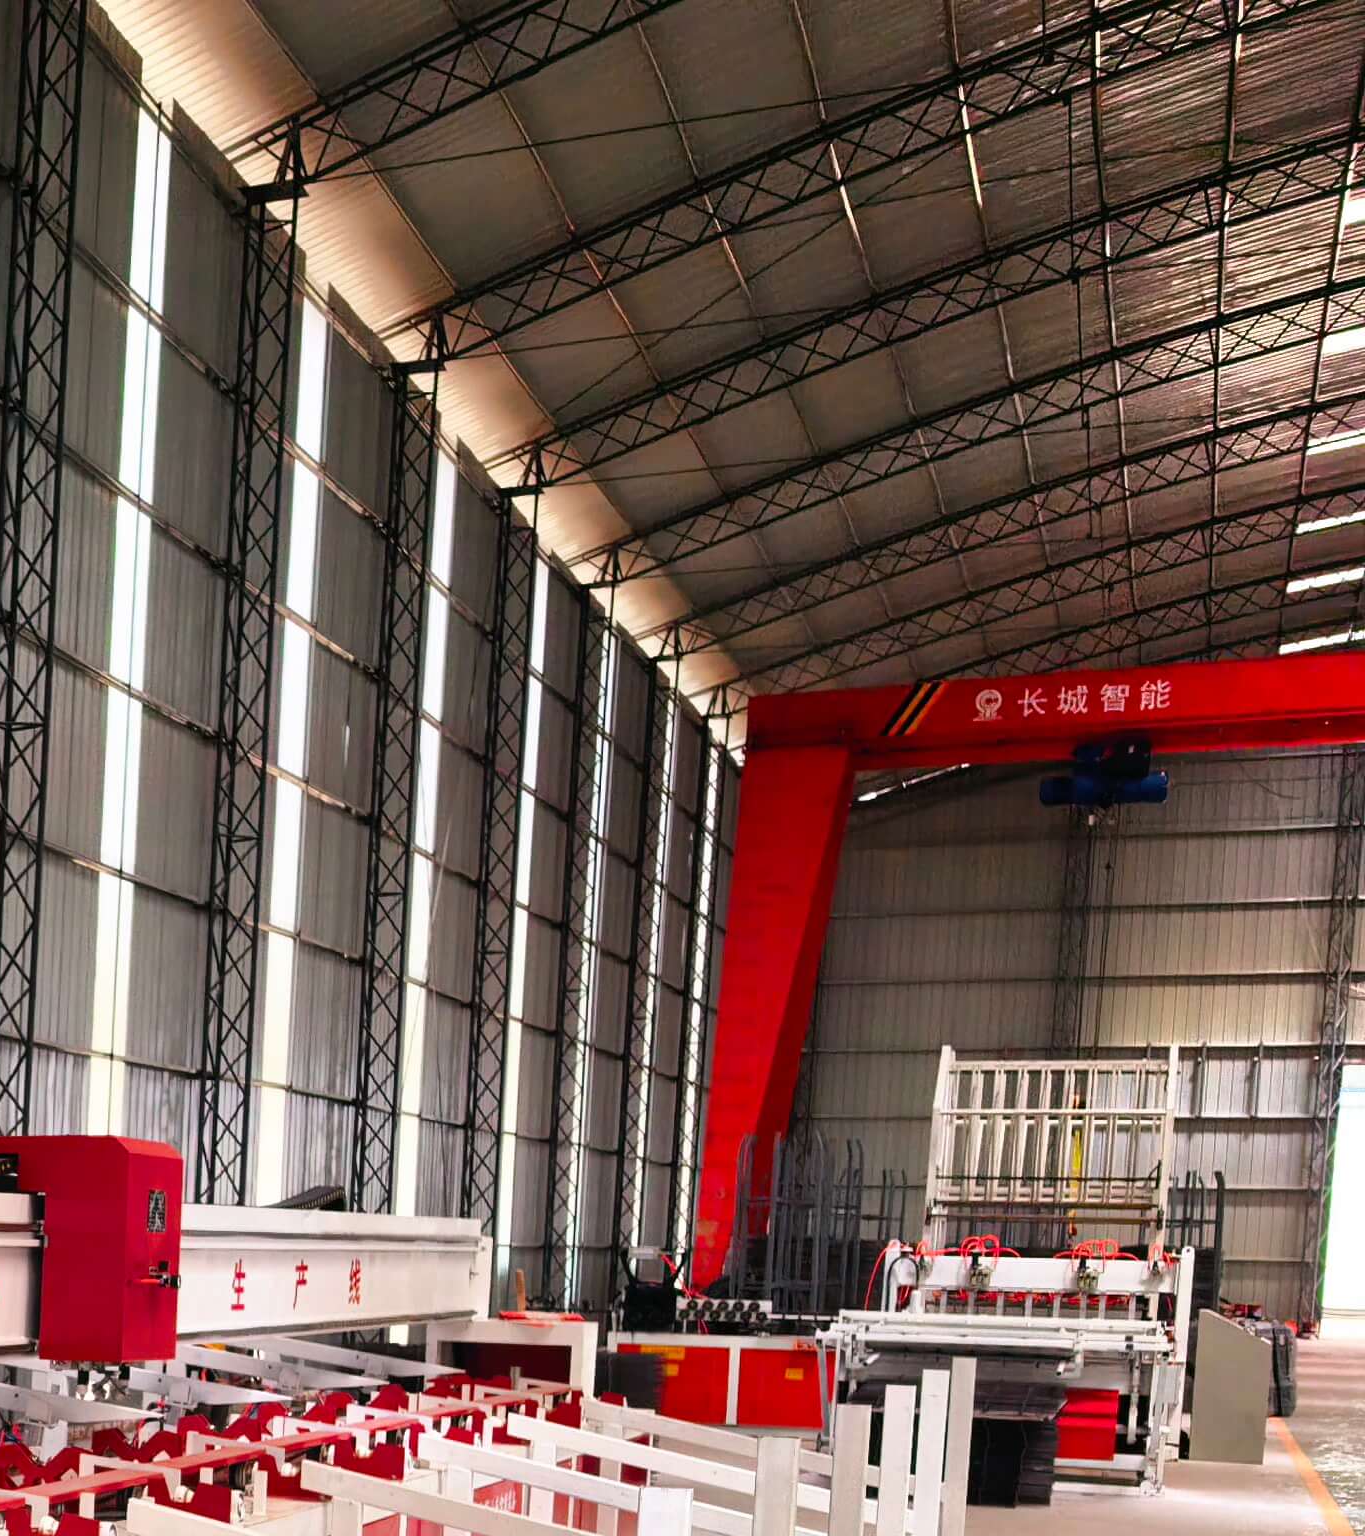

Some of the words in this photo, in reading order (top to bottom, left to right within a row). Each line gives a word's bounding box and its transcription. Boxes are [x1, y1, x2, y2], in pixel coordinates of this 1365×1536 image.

[1017, 679, 1173, 718] 长城智能
[230, 1257, 362, 1312] 生产线
